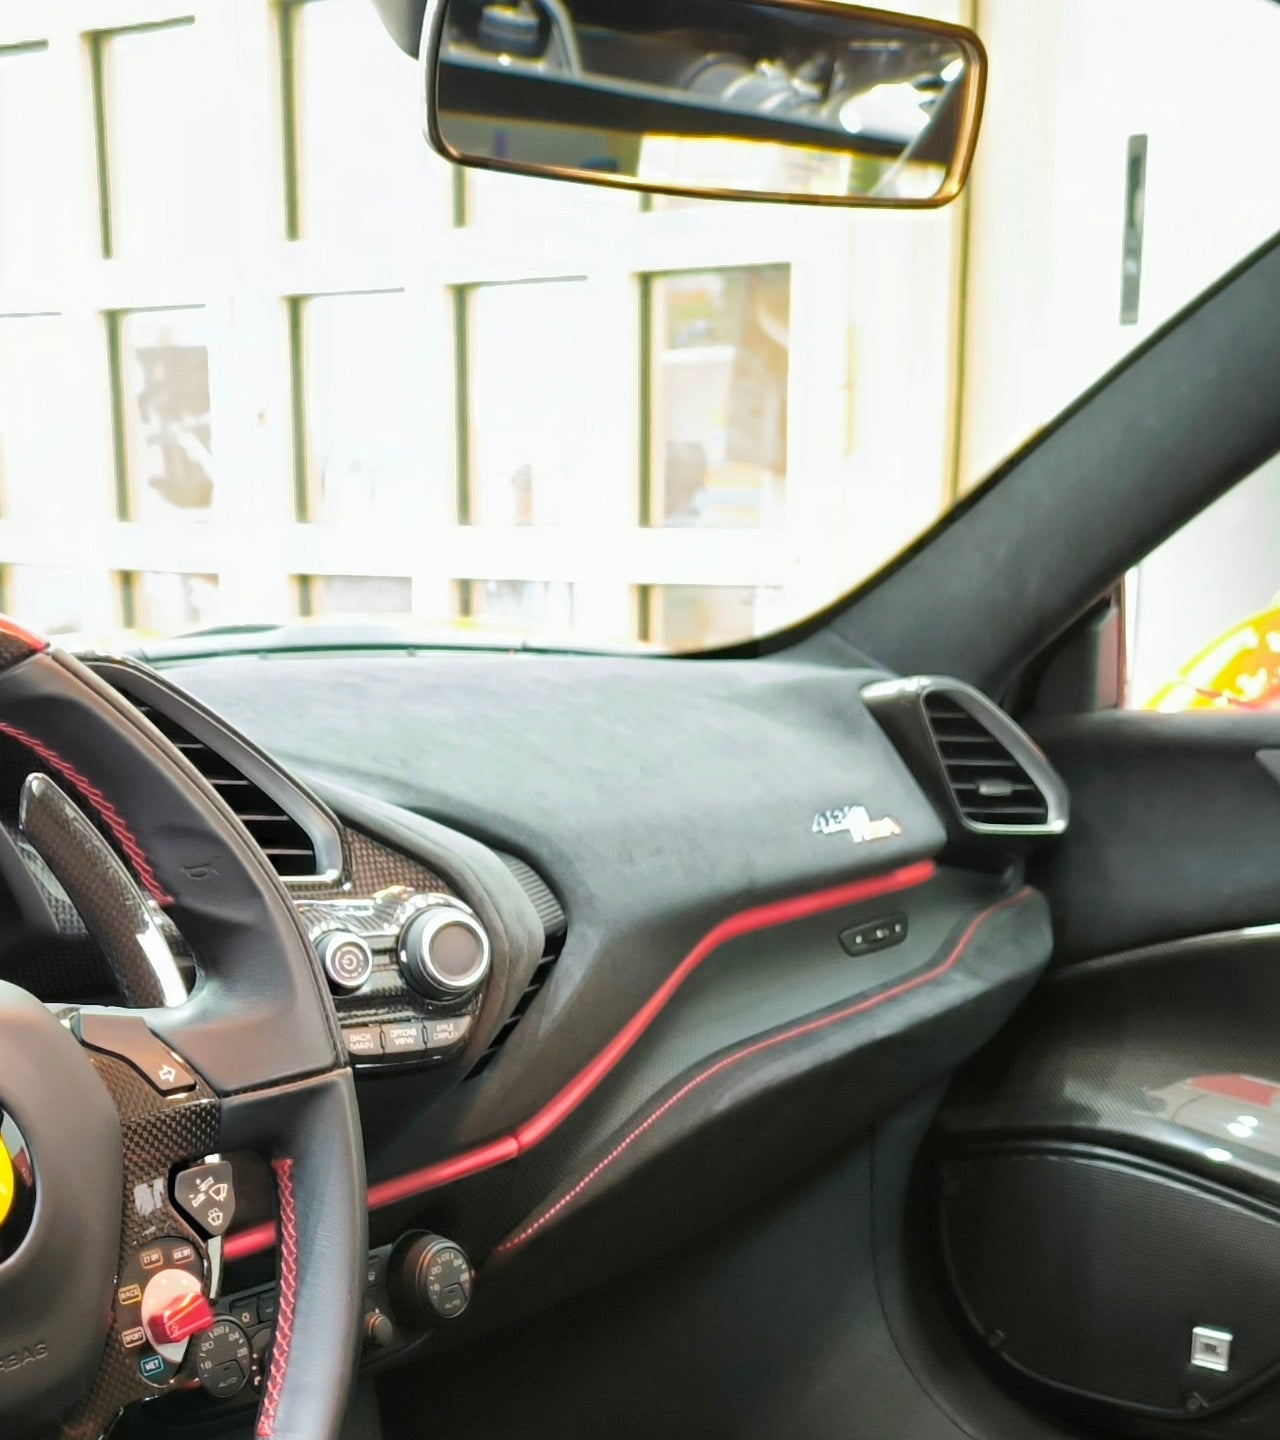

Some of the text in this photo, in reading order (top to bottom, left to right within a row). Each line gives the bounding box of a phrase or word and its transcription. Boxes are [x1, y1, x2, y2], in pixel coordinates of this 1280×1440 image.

[349, 1033, 372, 1043] BACK
[392, 1036, 415, 1046] VIEW
[349, 1040, 374, 1051] MAIN
[431, 1265, 442, 1275] 20
[119, 1287, 140, 1300] RACE
[123, 1332, 143, 1344] SPORT
[228, 1331, 240, 1341] 24
[201, 1341, 214, 1351] 20
[144, 1360, 160, 1371] WET
